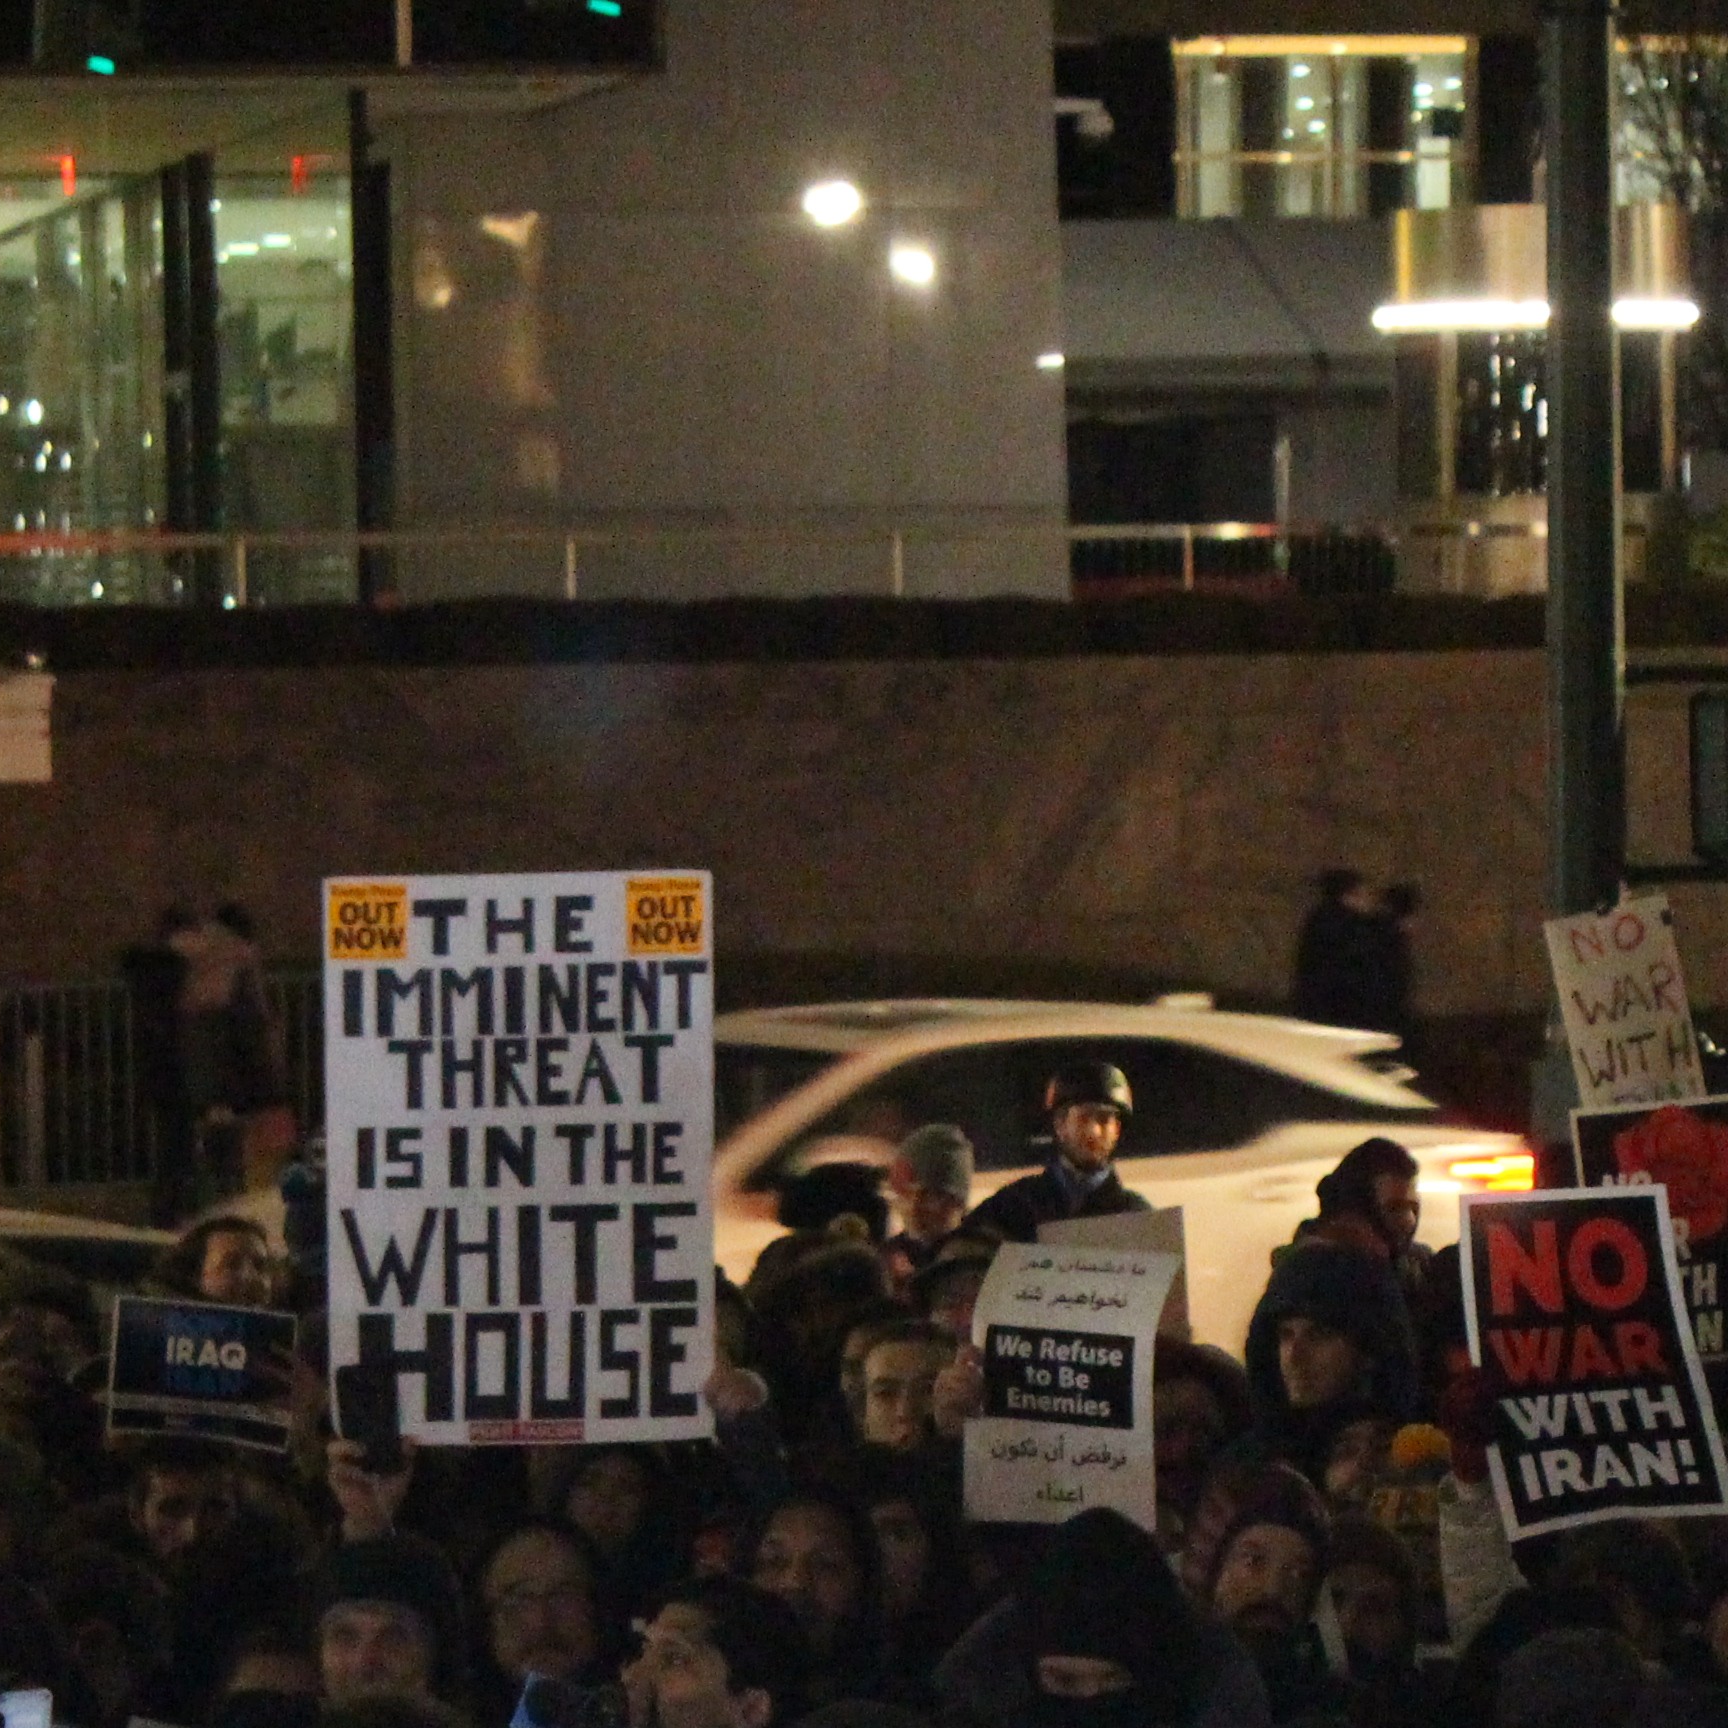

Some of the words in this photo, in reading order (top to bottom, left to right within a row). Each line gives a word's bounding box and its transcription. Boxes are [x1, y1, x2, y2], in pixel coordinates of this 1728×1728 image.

[333, 927, 405, 951] NOW
[338, 901, 400, 926] OUT
[413, 895, 595, 956] THE
[629, 920, 703, 945] NOW
[636, 896, 697, 921] OUT
[1569, 912, 1646, 966] NO
[342, 960, 708, 1038] IMMINENT
[1571, 959, 1682, 1026] WAR
[387, 1034, 675, 1110] THREAT
[1578, 1020, 1695, 1089] WITH
[356, 1126, 423, 1190] IS
[448, 1124, 536, 1189] IN
[555, 1121, 685, 1187] THE
[339, 1201, 698, 1308] WHITE
[1485, 1215, 1650, 1316] NO
[165, 1334, 249, 1371] IRAQ
[357, 1307, 700, 1422] HOUSE
[995, 1333, 1034, 1360] We
[1038, 1336, 1124, 1368] Refuse
[1024, 1364, 1052, 1387] to
[1058, 1366, 1092, 1390] Be
[1484, 1320, 1671, 1385] WAR
[1005, 1386, 1113, 1419] Enemies
[1499, 1384, 1688, 1442] WITH
[1516, 1437, 1702, 1503] IRAN!
